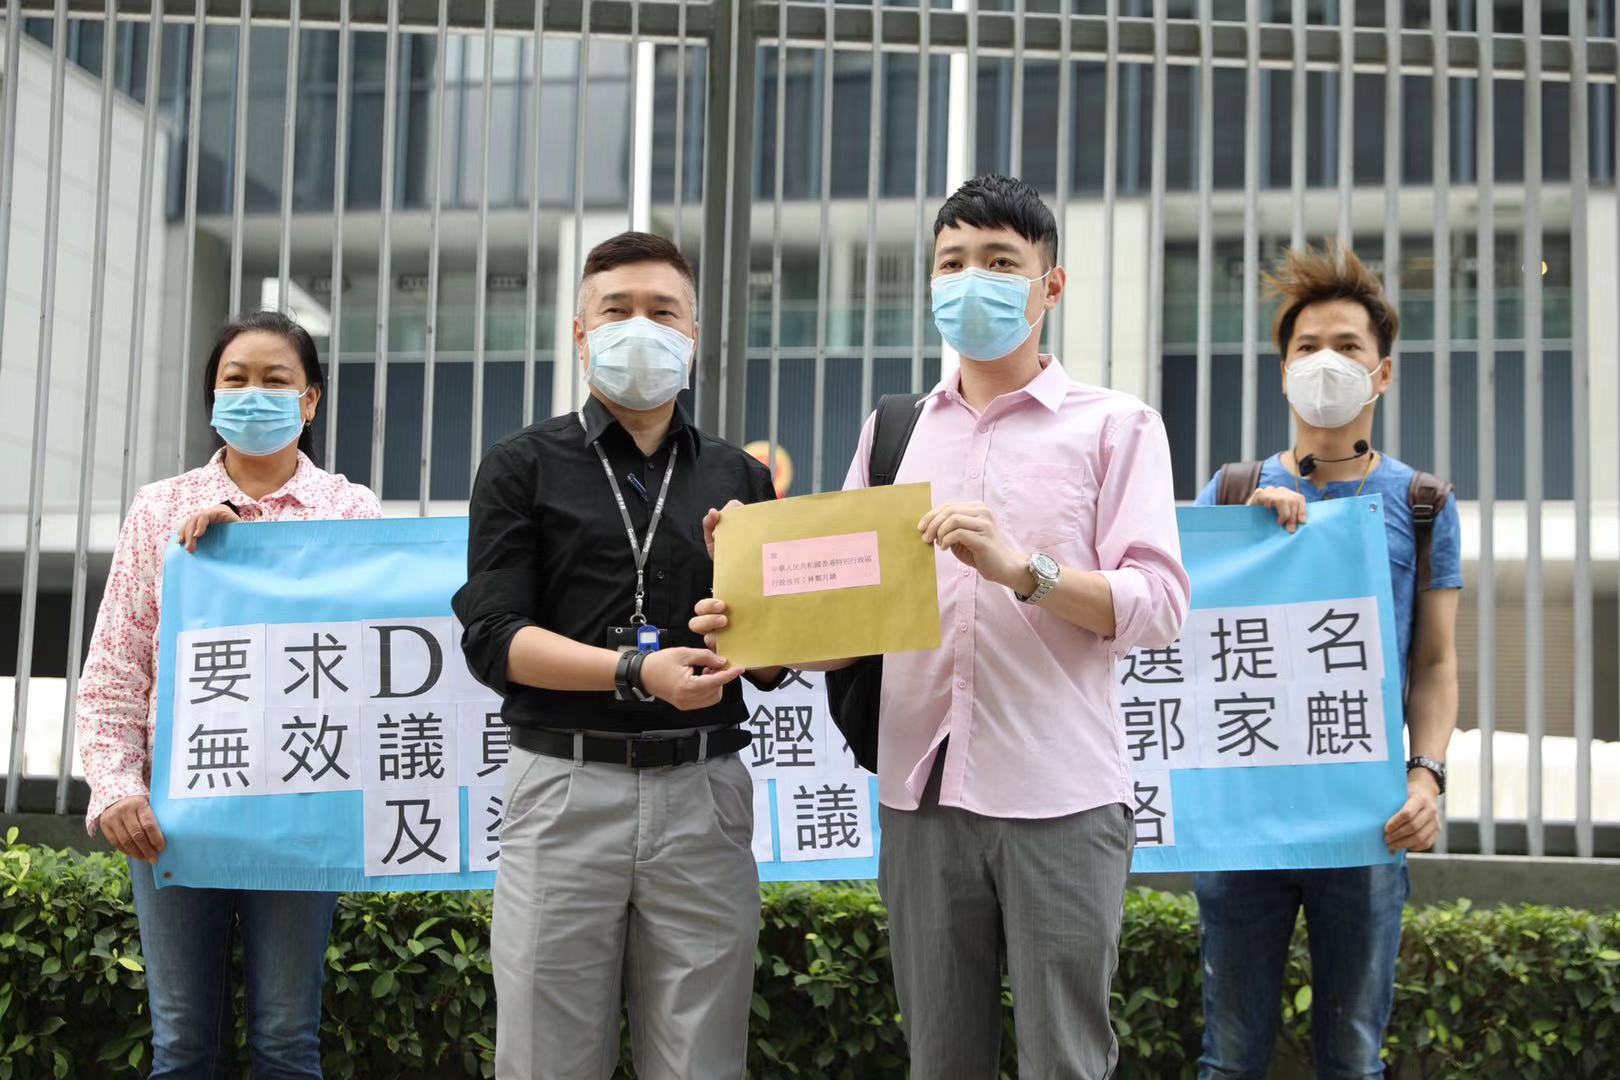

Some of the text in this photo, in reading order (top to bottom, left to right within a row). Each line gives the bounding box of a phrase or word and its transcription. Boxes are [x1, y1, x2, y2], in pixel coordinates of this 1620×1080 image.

[1120, 689, 1373, 762] 郭家麒
[793, 783, 861, 851] 議
